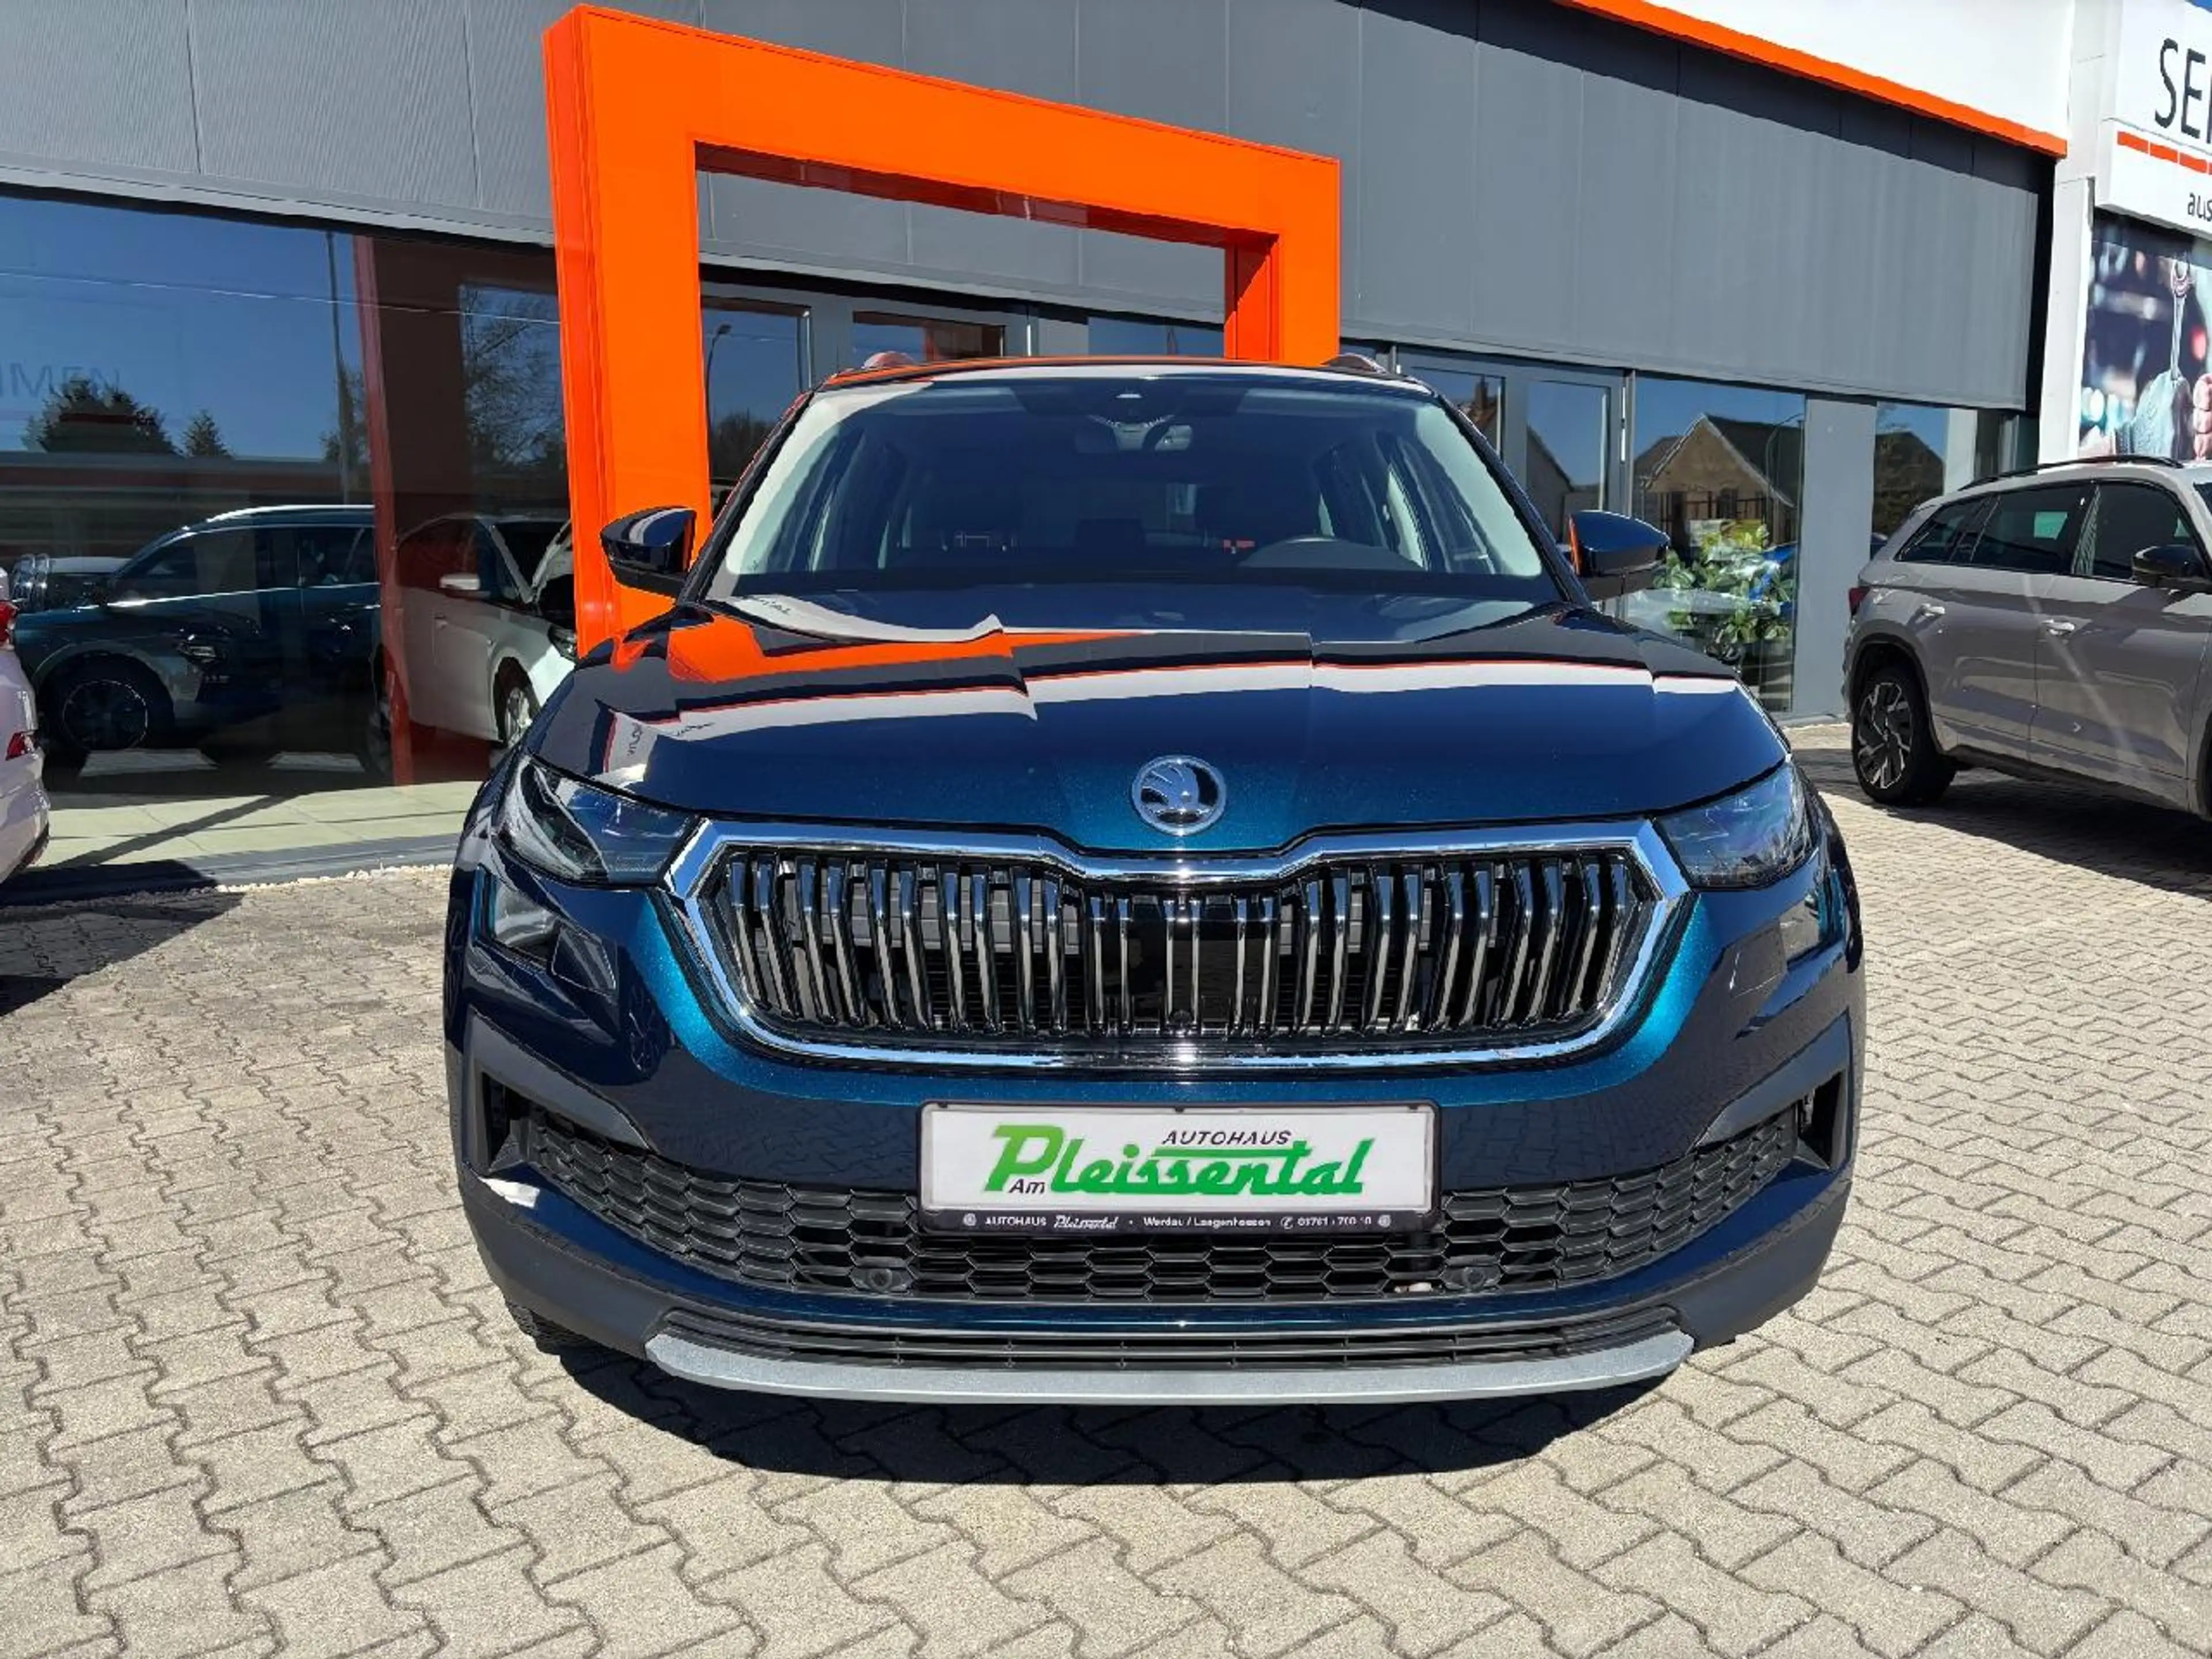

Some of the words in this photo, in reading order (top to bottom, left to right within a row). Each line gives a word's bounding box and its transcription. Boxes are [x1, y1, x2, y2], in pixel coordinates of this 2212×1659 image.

[2155, 38, 2212, 143] SE
[0, 362, 120, 399] MEN
[1162, 1130, 1292, 1145] AUTOHAUS
[984, 1125, 1375, 1194] Pleissental
[1009, 1179, 1046, 1194] Am
[985, 1217, 1047, 1226] AUTOHAUS
